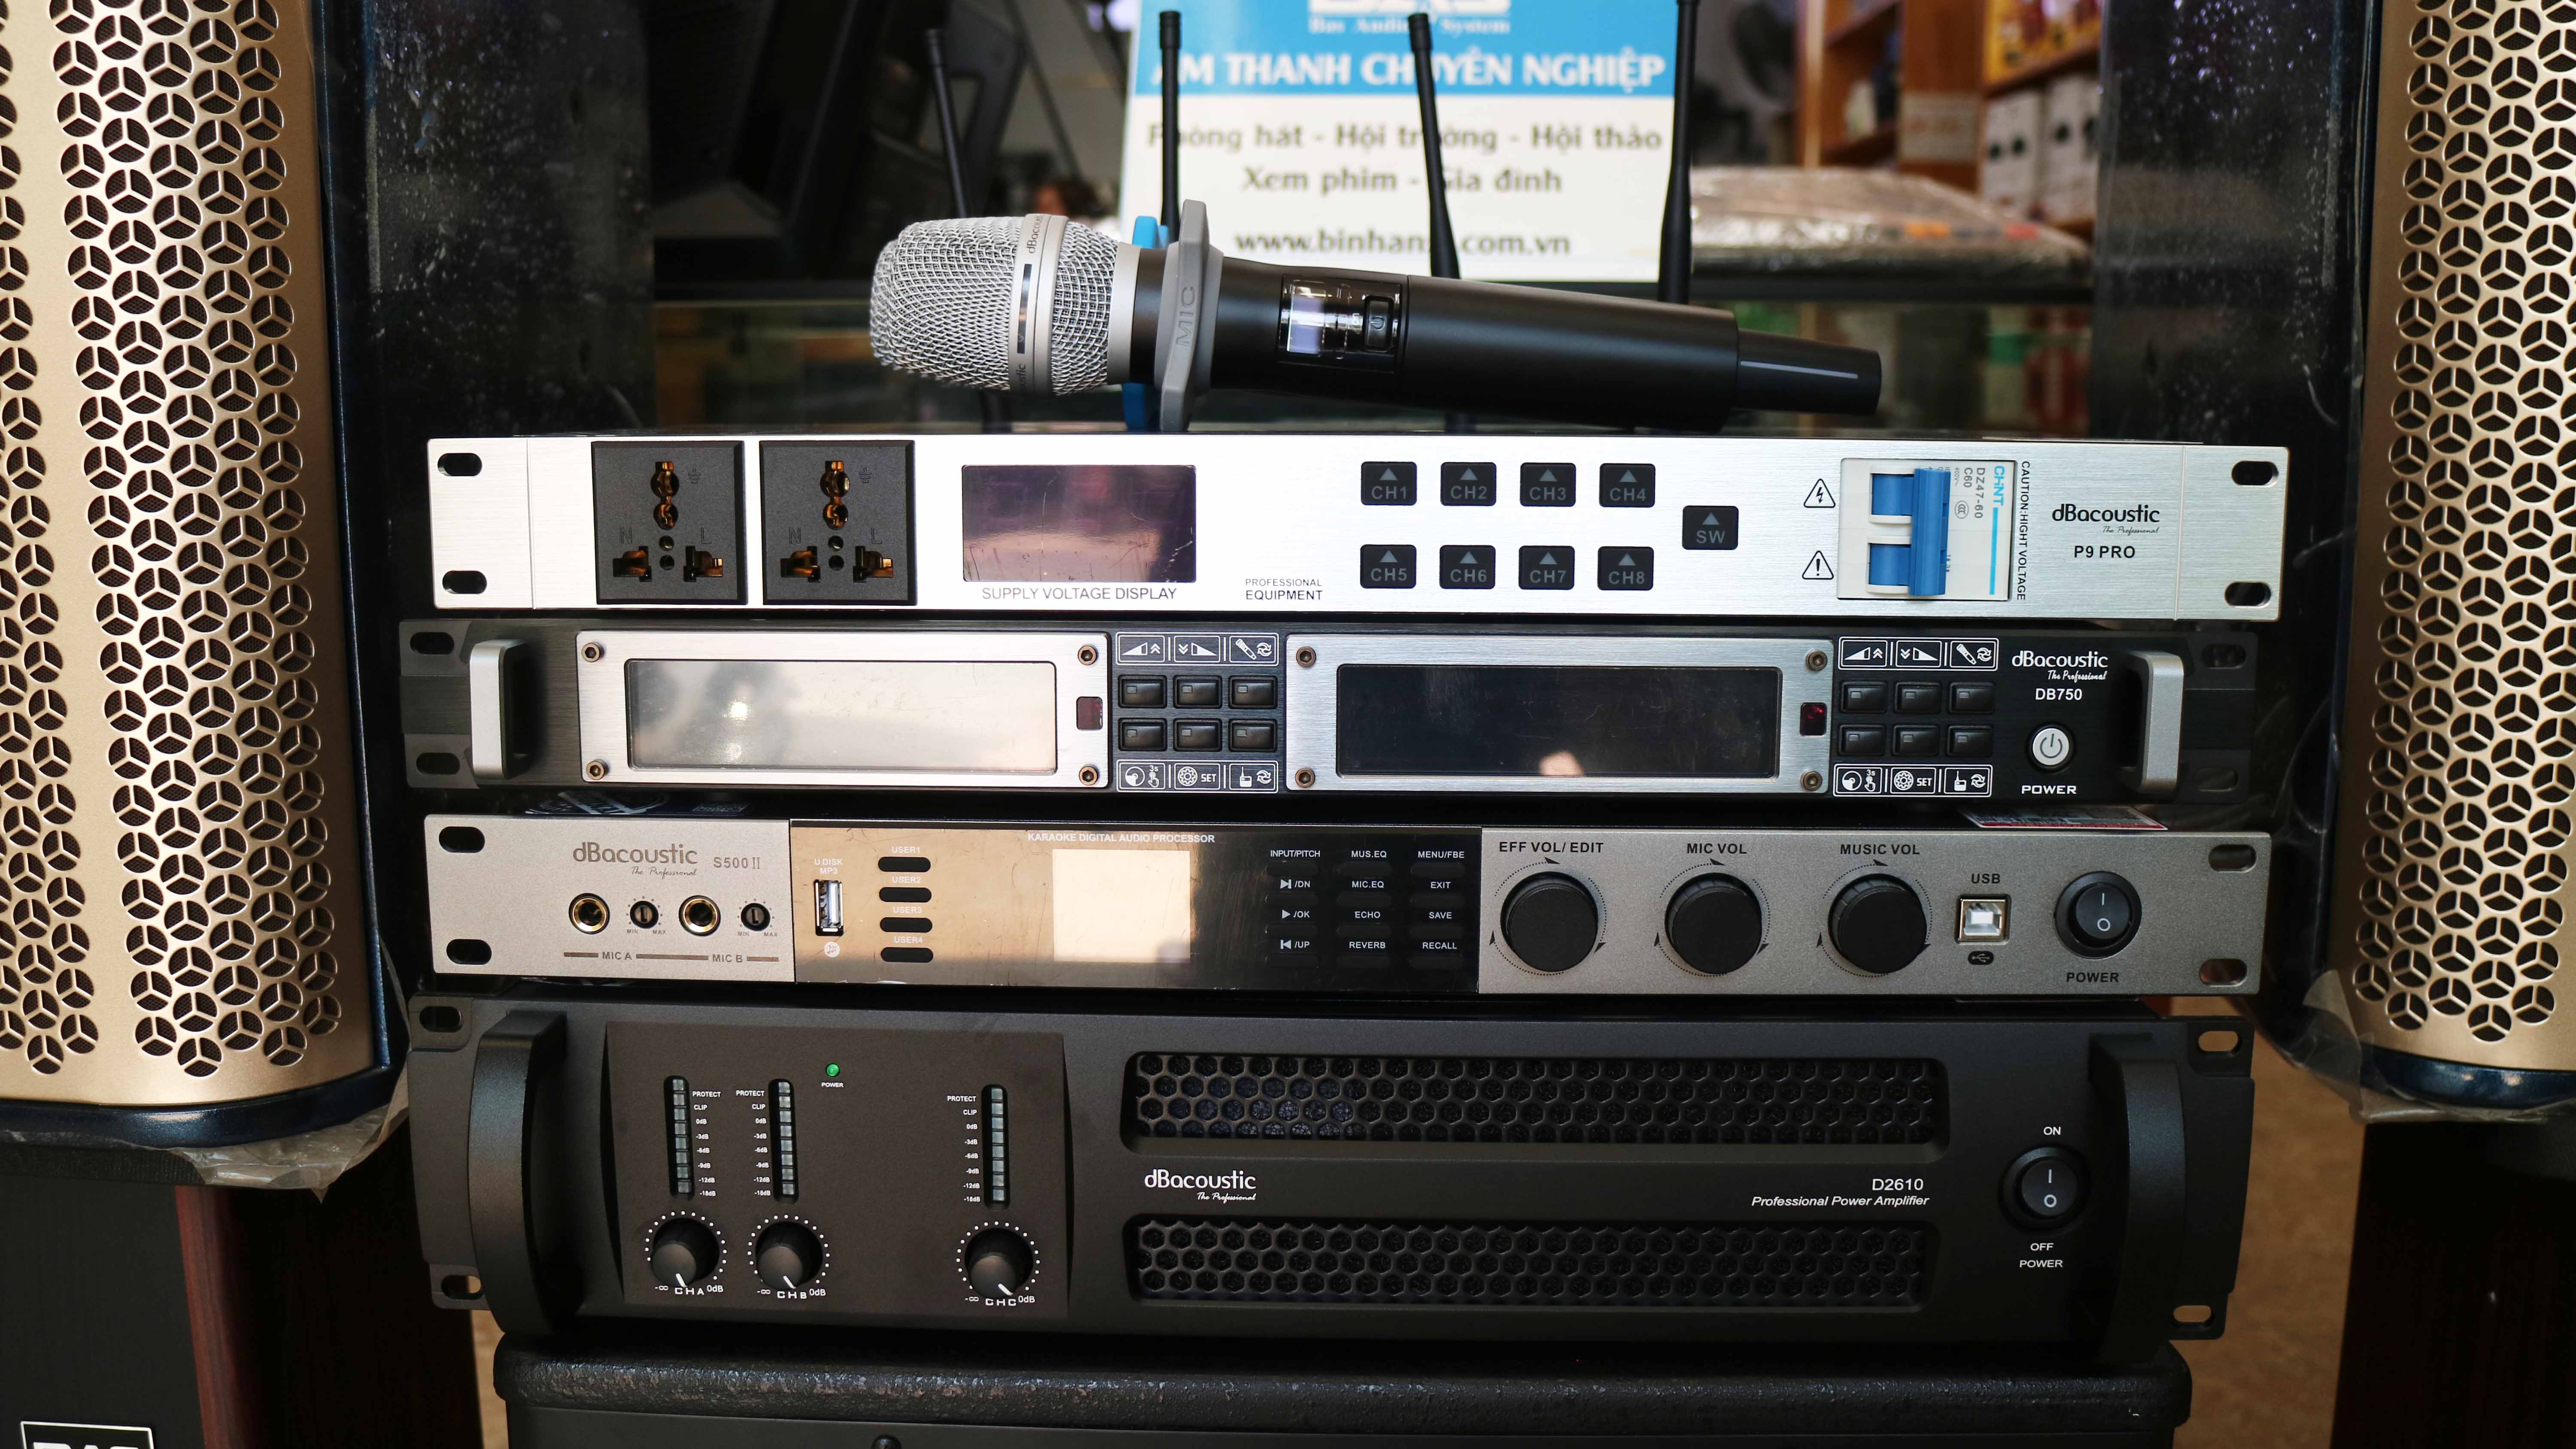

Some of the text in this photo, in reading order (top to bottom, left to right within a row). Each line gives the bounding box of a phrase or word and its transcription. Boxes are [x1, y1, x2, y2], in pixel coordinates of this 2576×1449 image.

[1151, 53, 1215, 85] M
[1224, 53, 1352, 85] THANH
[1523, 45, 1666, 94] NGHIỆP
[1336, 124, 1385, 154] Hội
[1531, 125, 1581, 155] Hội
[1243, 168, 1309, 191] Xem
[1321, 168, 1397, 197] phim
[1176, 286, 1195, 347] MIC
[1964, 467, 1973, 488] C60
[1371, 486, 1407, 500] CH1
[1450, 486, 1487, 500] CH2
[1530, 487, 1567, 501] CH3
[1610, 488, 1646, 502] CH4
[1975, 467, 1985, 518] DZ47-60
[2052, 503, 2160, 522] dBacoustic
[1696, 530, 1725, 544] SW
[2117, 526, 2160, 536] Professional
[2074, 546, 2135, 558] P9 PRO
[1371, 568, 1407, 582] CH5
[1450, 569, 1487, 583] CH6
[1530, 570, 1567, 584] CH7
[1608, 571, 1645, 585] CH8
[2017, 551, 2027, 600] VOLTAGE
[1245, 579, 1322, 587] PROFESSIONAL
[982, 588, 1177, 600] SUPPLY VOLTAGE DISPLAY
[1246, 590, 1323, 600] EQUIPMENT
[2012, 650, 2108, 667] dBacoustic
[2047, 670, 2108, 683] The Professional
[2035, 688, 2082, 700] DB750
[1201, 773, 1217, 782] SET
[1917, 778, 1932, 787] SET
[2021, 785, 2077, 794] POWER
[1028, 833, 1215, 843] KARAOKE DIGITAL AUDIO PROCESSOR
[573, 842, 698, 864] dBacoustic
[1499, 842, 1527, 853] EFF
[1570, 842, 1604, 853] EDIT
[1686, 843, 1747, 854] MIC VOL
[1840, 843, 1920, 855] MUSIC VOL
[631, 866, 698, 879] The Professional
[1971, 873, 2001, 884] USB
[1352, 881, 1385, 889] MIC.EQ
[602, 952, 622, 960] MIC
[712, 954, 743, 963] MIC B
[2066, 972, 2119, 983] POWER
[2043, 1127, 2061, 1135] ON
[1144, 1169, 1256, 1189] dBacoustic
[1872, 1178, 1924, 1191] D2610
[1197, 1191, 1257, 1203] The Professional
[1752, 1195, 1929, 1207] Professional Power Amplifier
[2030, 1243, 2054, 1251] OFF
[2019, 1260, 2063, 1268] POWER
[707, 1285, 724, 1293] 0dB
[809, 1288, 826, 1297] 0dB
